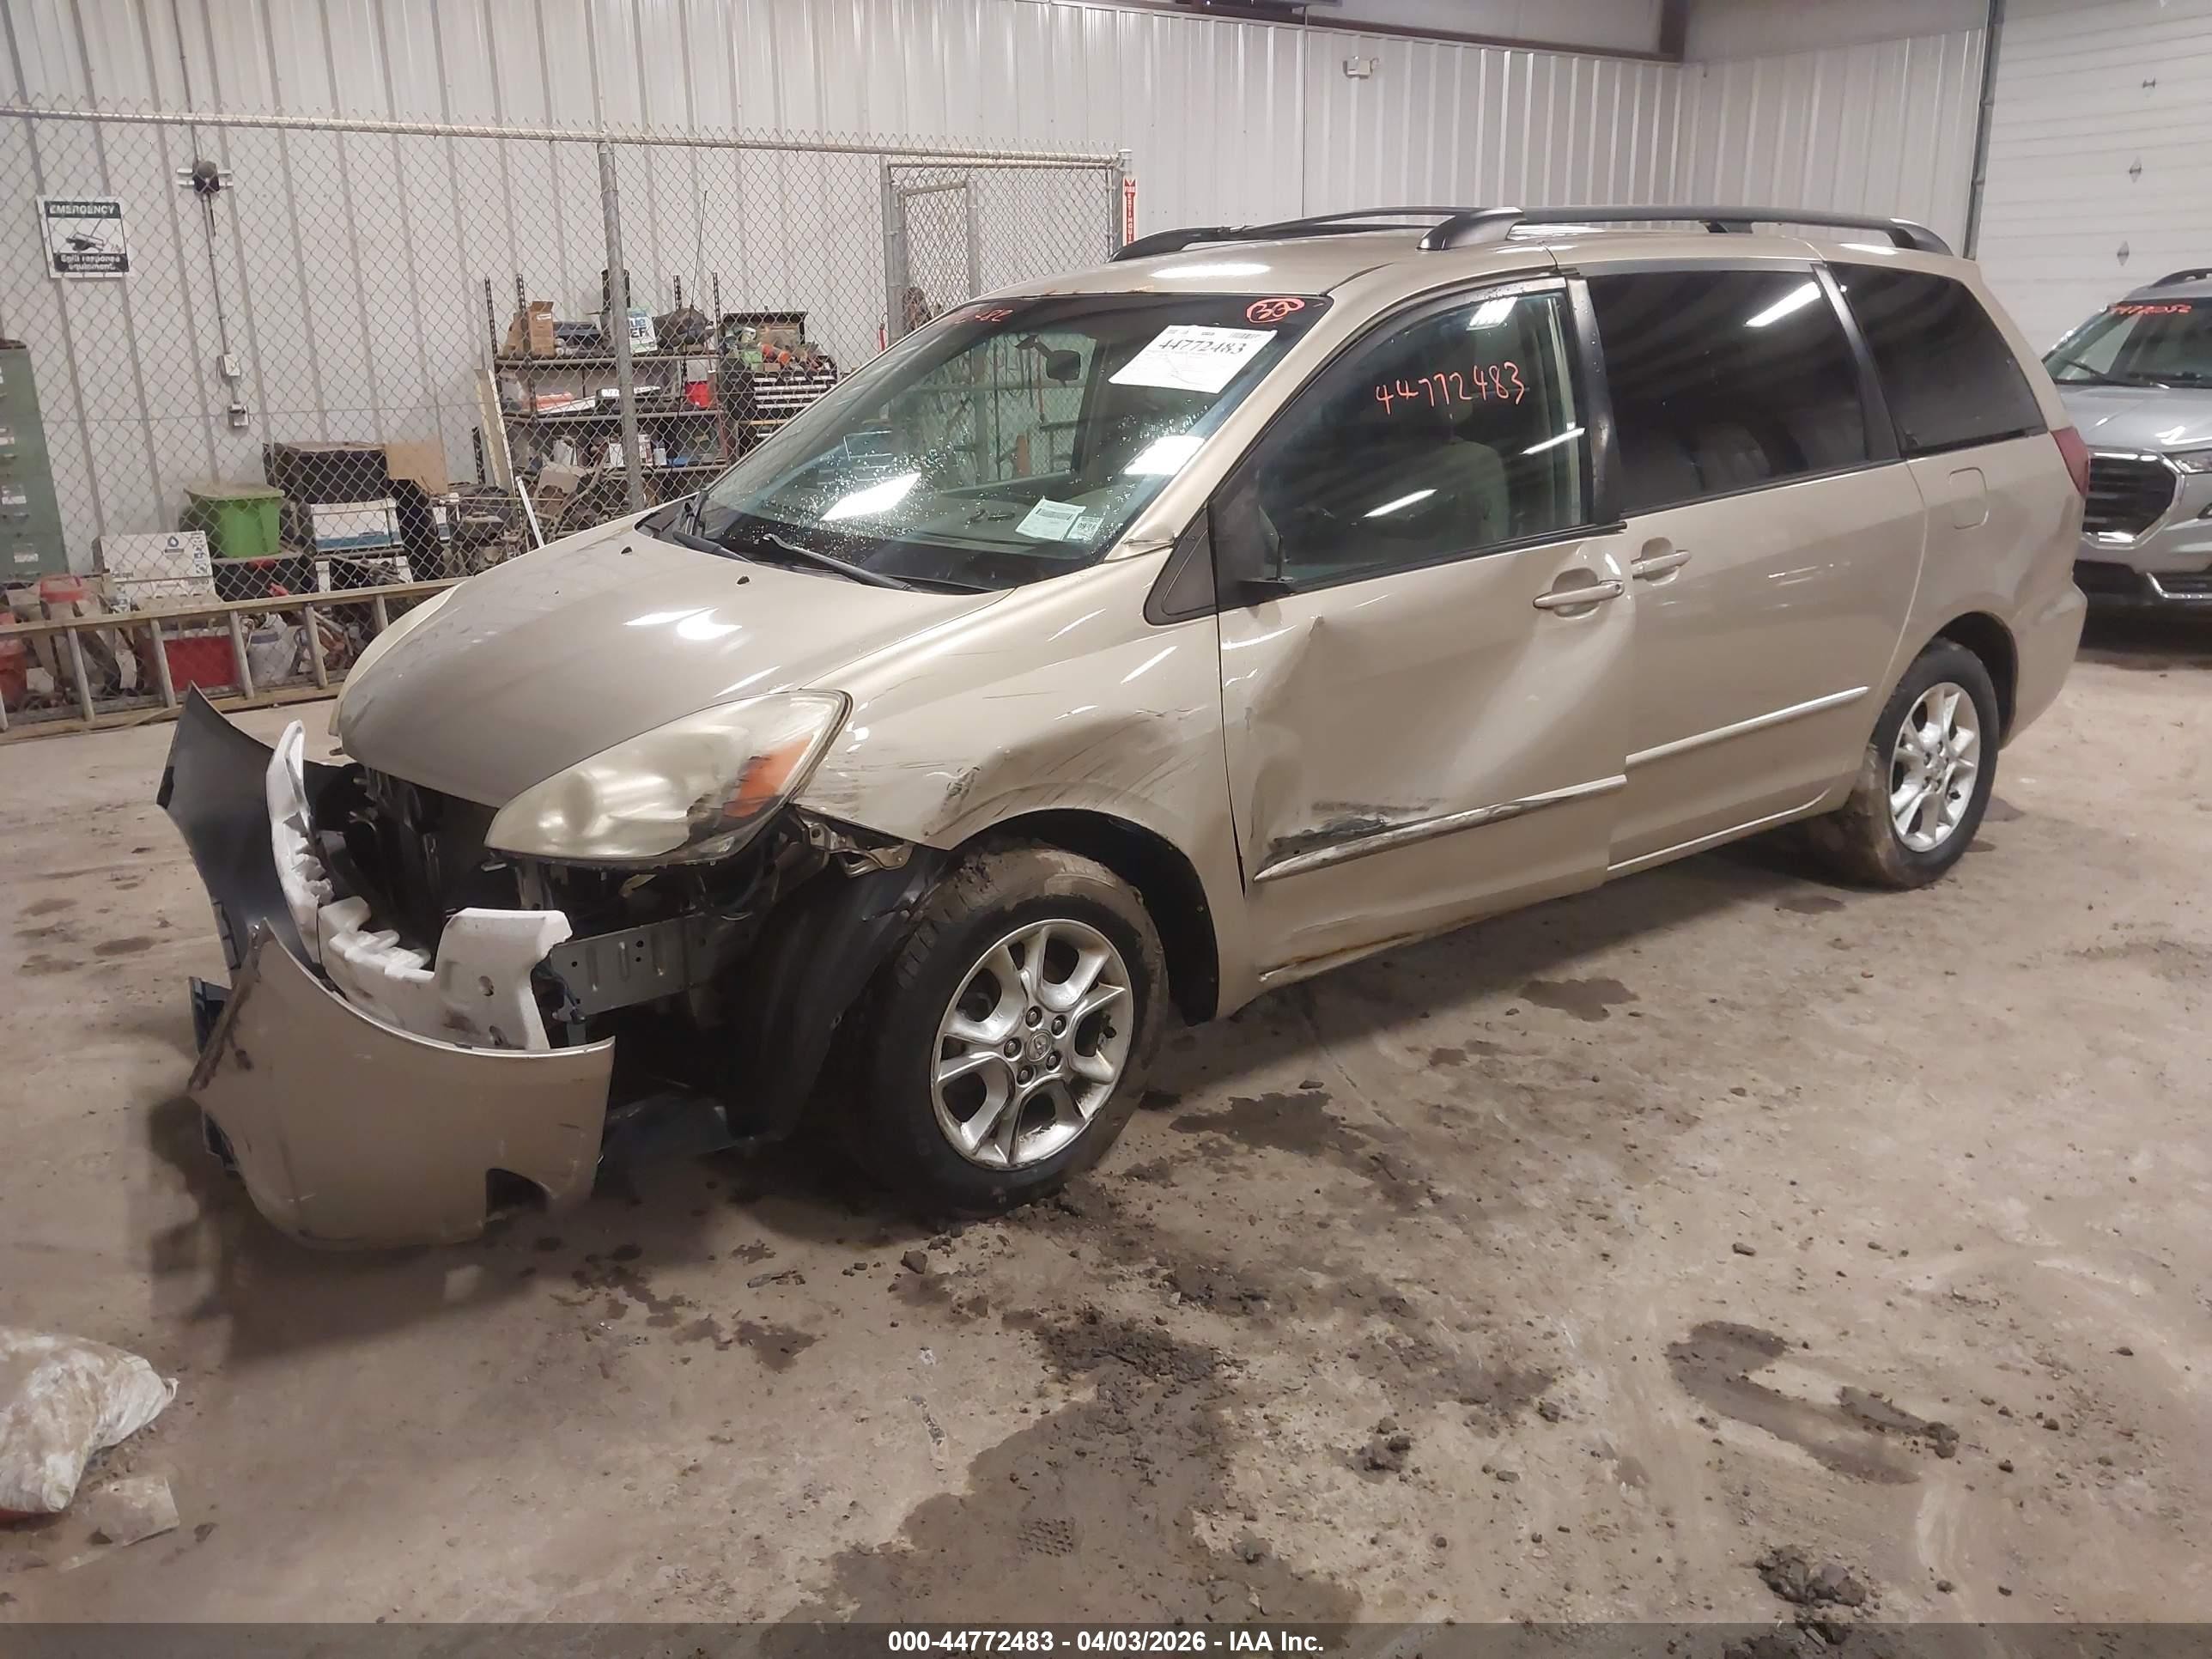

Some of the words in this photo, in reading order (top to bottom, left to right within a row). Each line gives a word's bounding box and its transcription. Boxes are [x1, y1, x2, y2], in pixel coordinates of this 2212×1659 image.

[49, 204, 115, 215] EMERGENCY
[629, 326, 647, 337] EF
[1159, 338, 1247, 355] 44772483
[1376, 362, 1524, 415] 44772483
